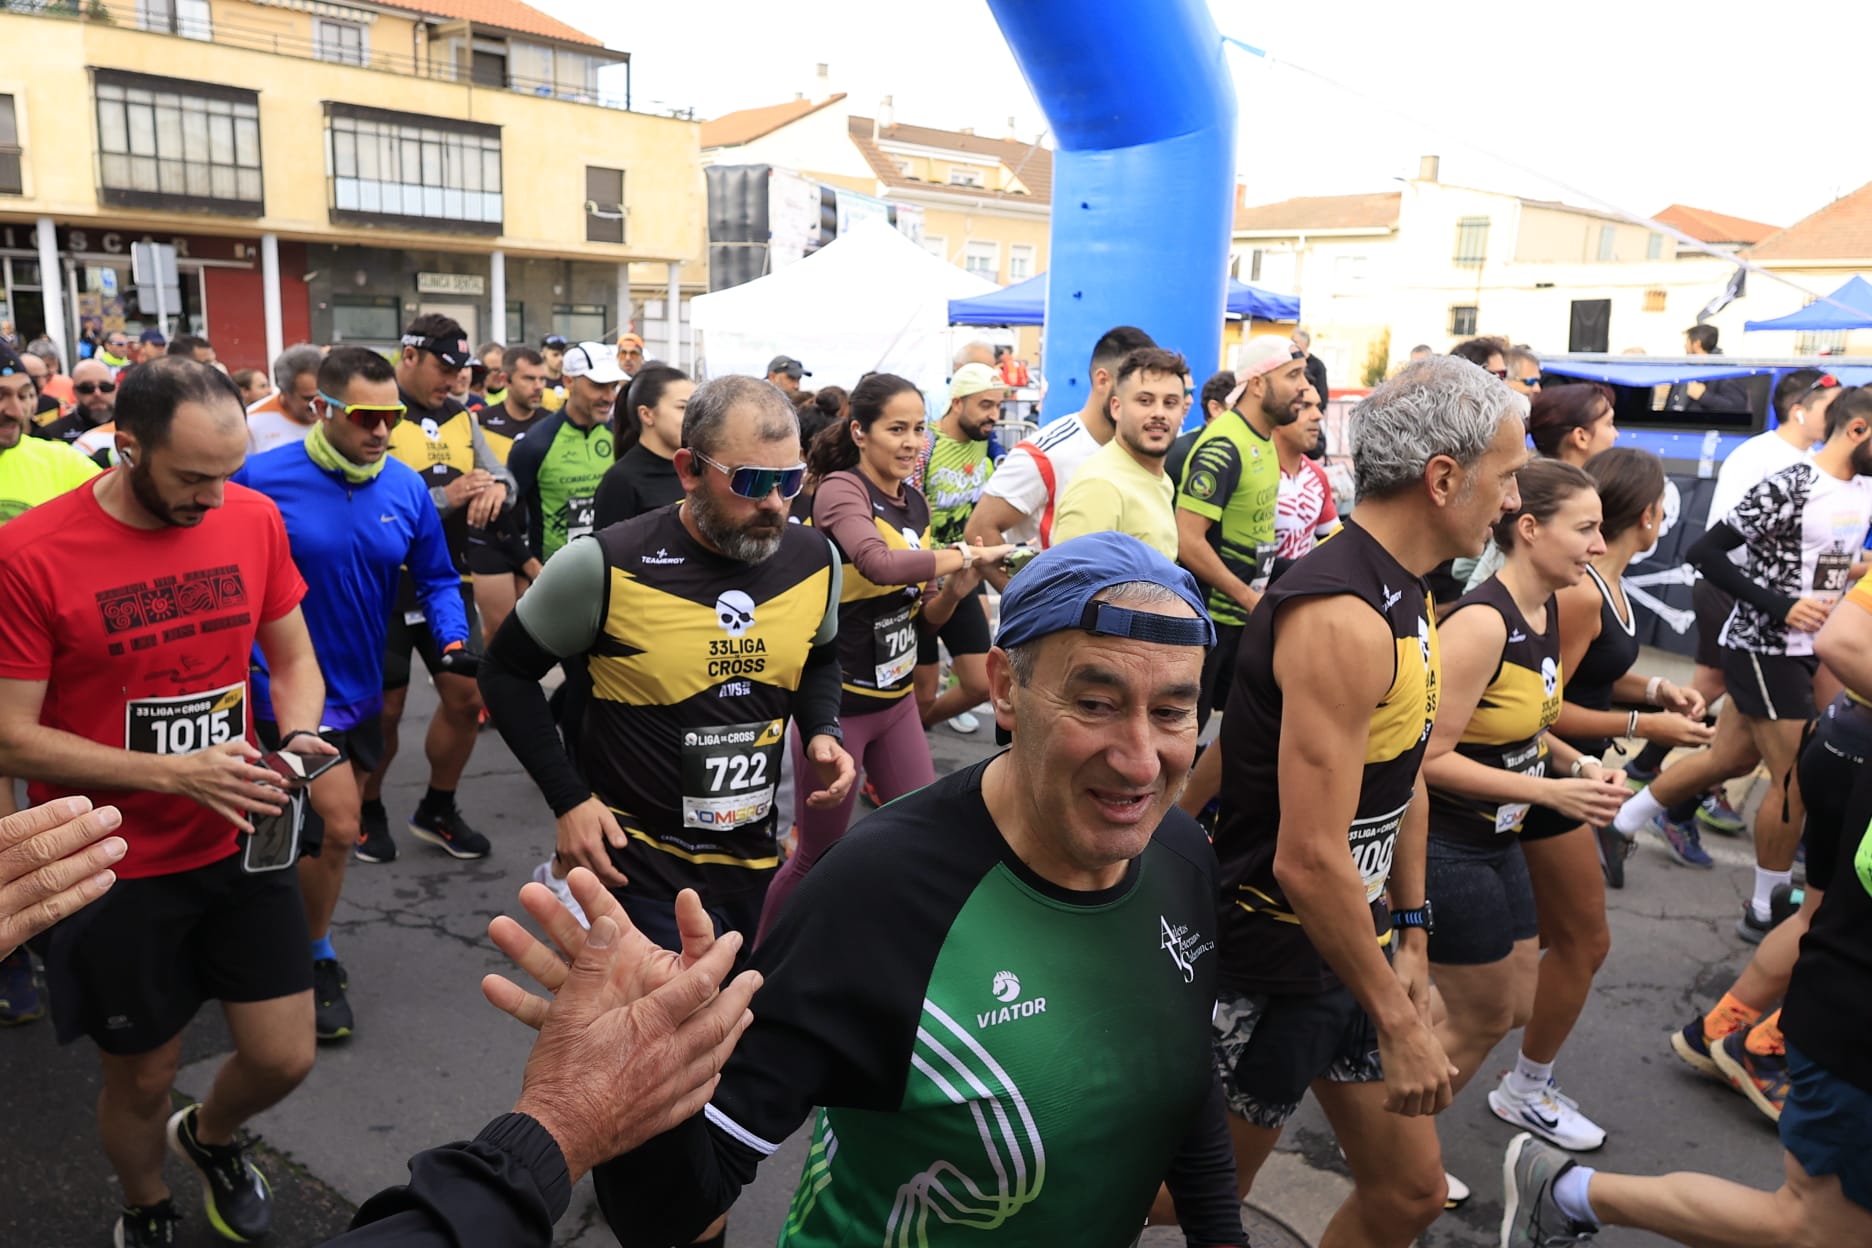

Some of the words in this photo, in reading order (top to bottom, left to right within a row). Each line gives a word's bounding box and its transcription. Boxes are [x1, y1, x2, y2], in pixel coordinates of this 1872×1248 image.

[641, 555, 685, 565] TEAMERGY
[709, 638, 767, 656] 33LIGA
[885, 622, 916, 657] 704
[708, 658, 766, 677] CROSS
[719, 682, 743, 698] AVS
[136, 706, 149, 717] 33
[150, 704, 174, 717] LIGA
[182, 700, 211, 714] CROSS
[151, 709, 231, 755] 1015
[698, 734, 720, 746] LIGA
[727, 730, 755, 743] CROSS
[705, 751, 768, 792] 722
[1358, 827, 1376, 839] LIGA
[977, 997, 1046, 1028] VIATOR
